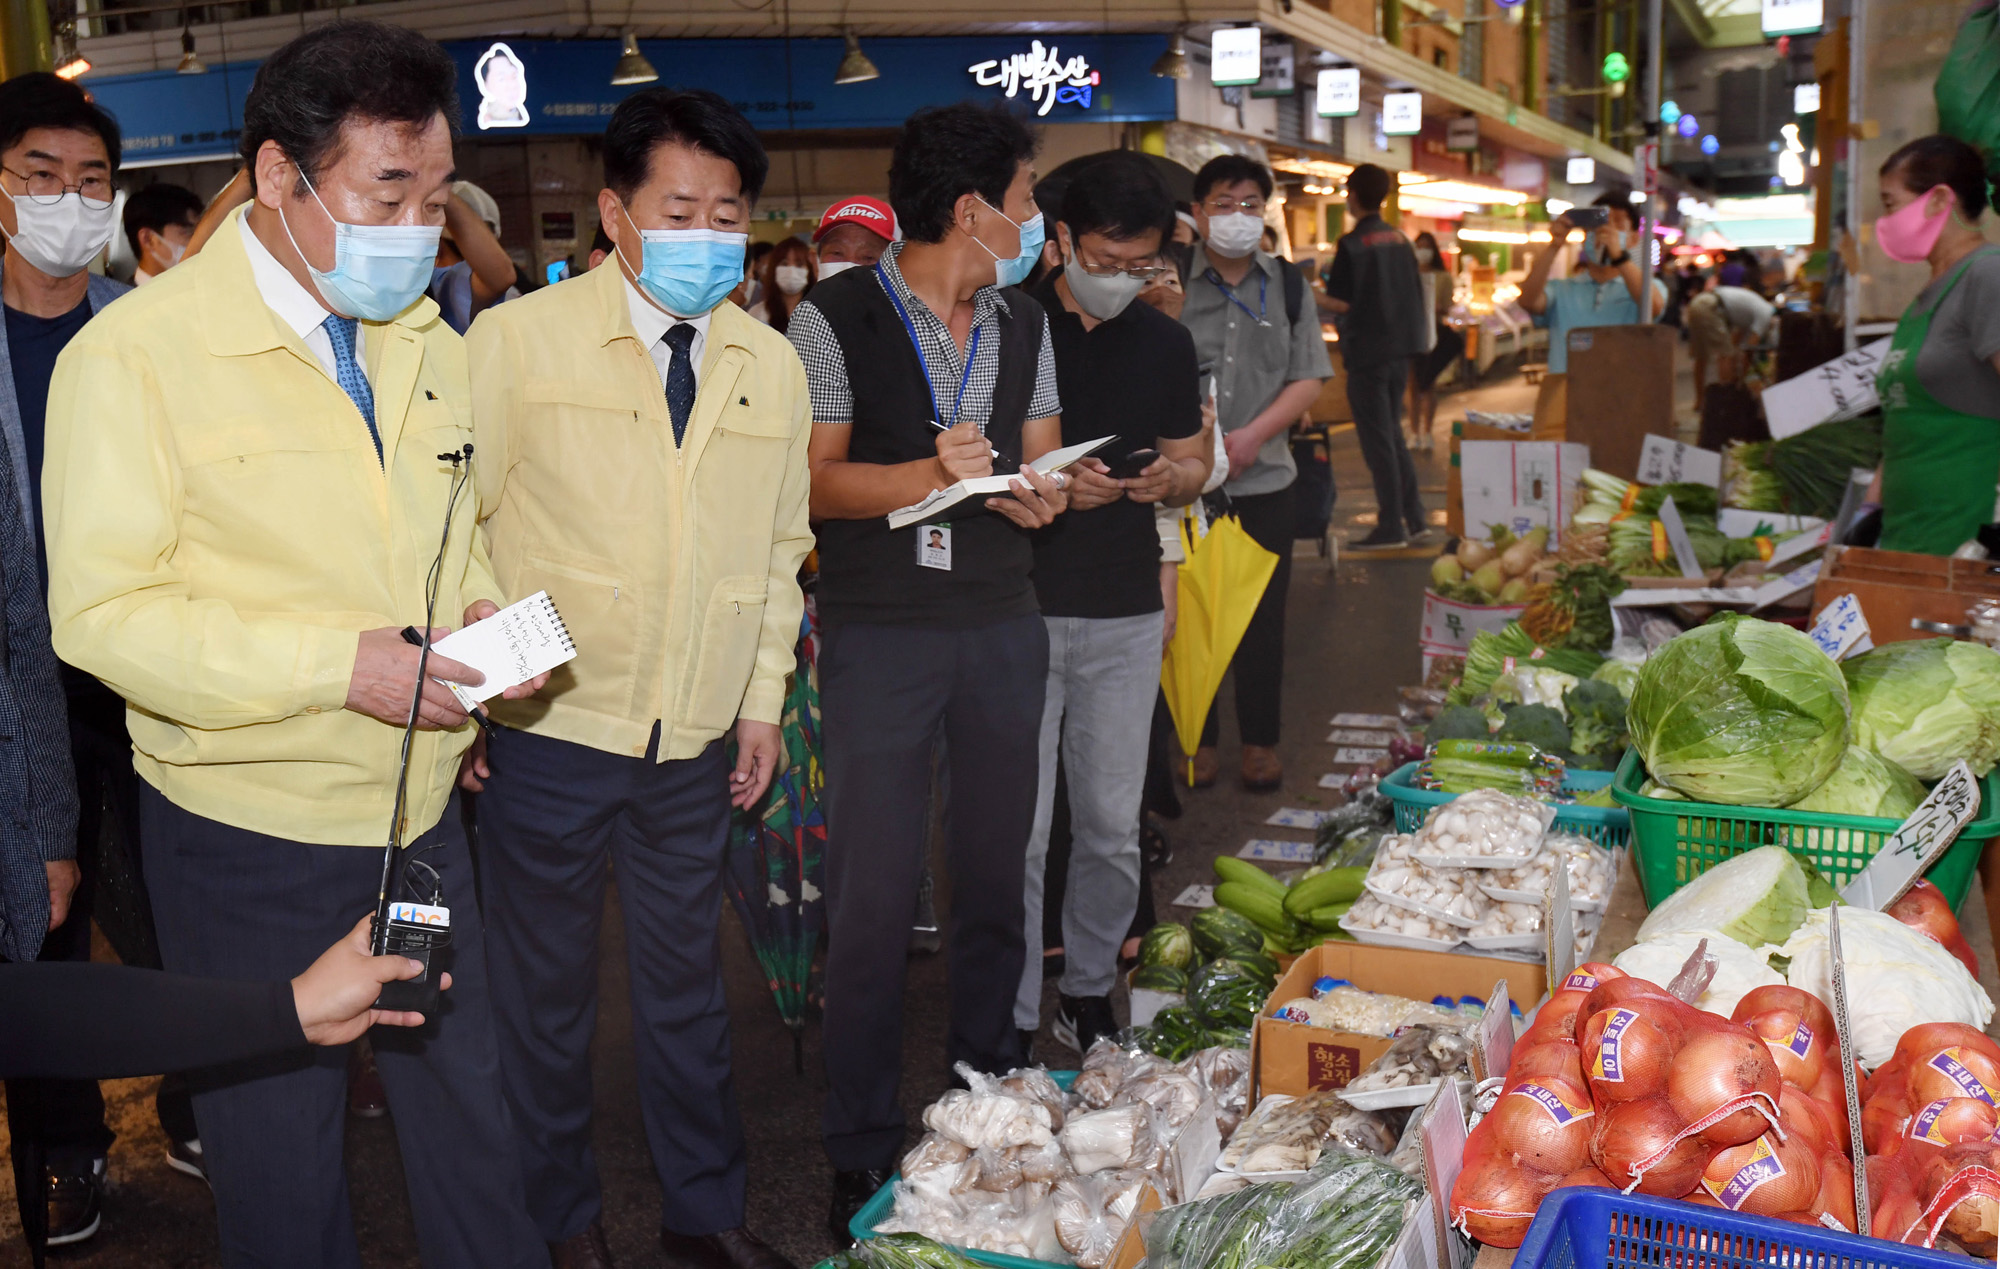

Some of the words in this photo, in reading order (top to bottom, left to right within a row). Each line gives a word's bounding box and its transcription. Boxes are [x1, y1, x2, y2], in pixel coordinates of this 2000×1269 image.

[1444, 612, 1466, 640] 무
[1314, 1046, 1351, 1068] 황소
[1602, 1016, 1626, 1072] 신토불이
[1318, 1067, 1351, 1084] 고집
[1946, 1060, 1985, 1098] 국내산
[1525, 1084, 1562, 1110] 국내산
[1728, 1161, 1767, 1196] 국내산
